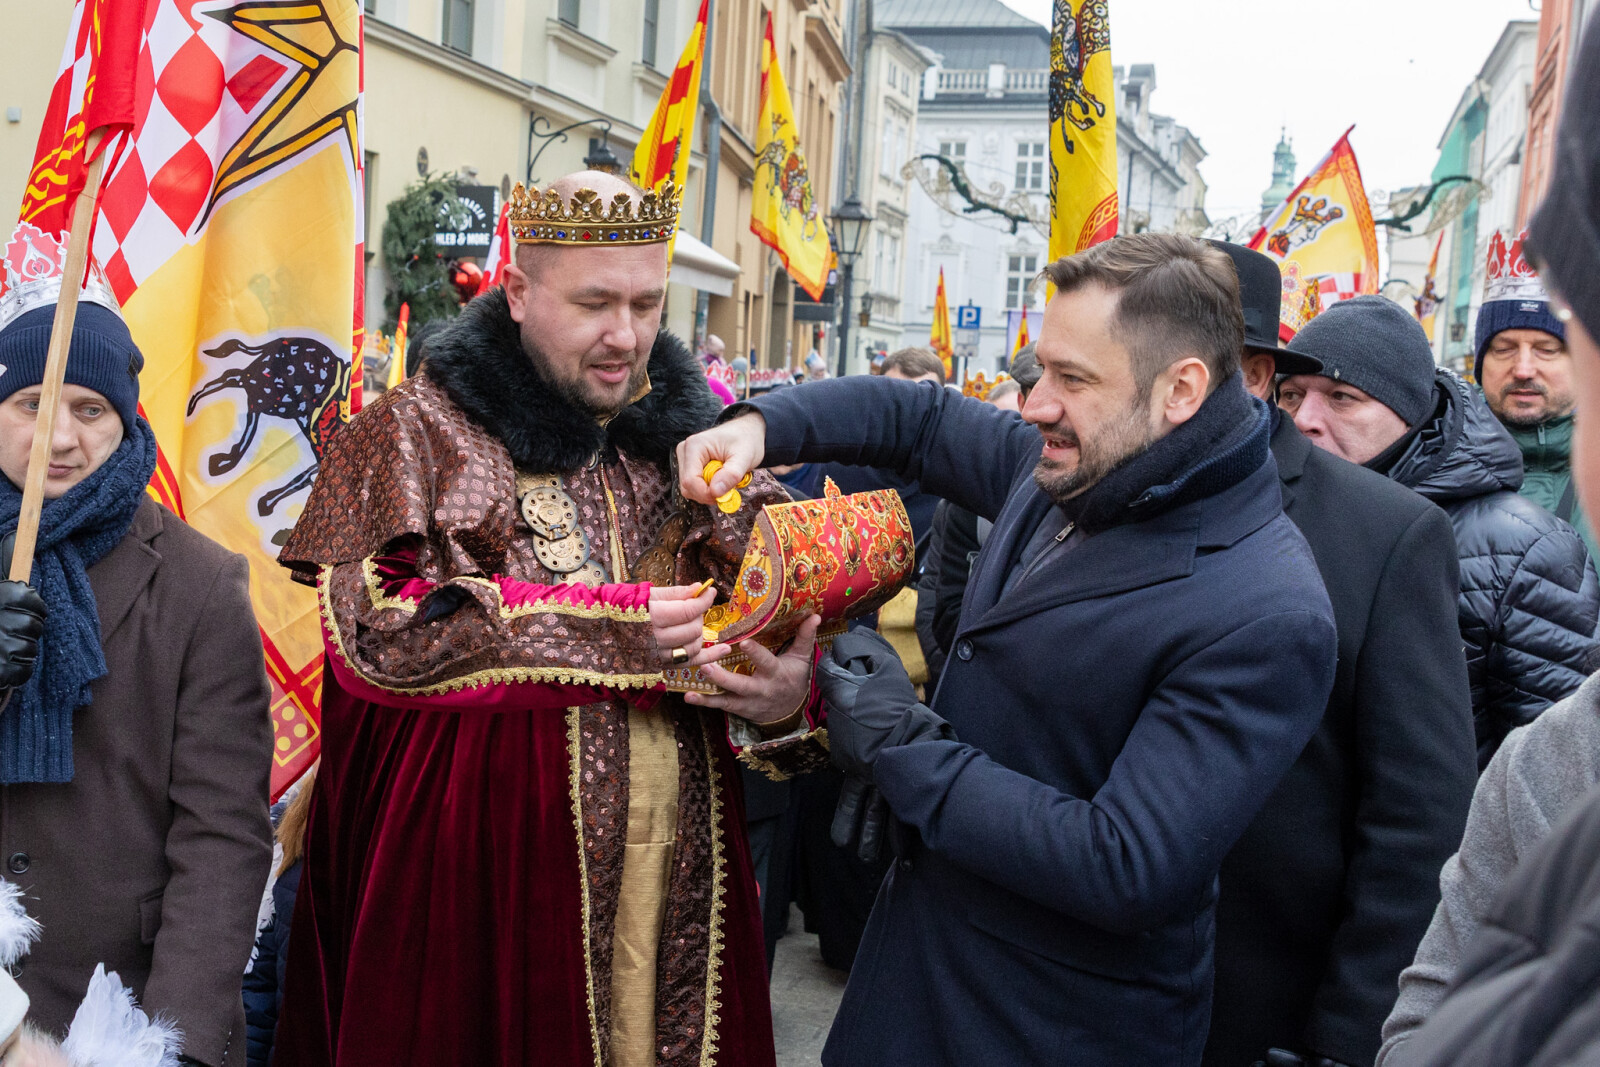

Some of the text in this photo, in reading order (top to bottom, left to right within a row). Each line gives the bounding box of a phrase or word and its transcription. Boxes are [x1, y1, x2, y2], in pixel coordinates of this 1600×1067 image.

[457, 232, 466, 246] &
[466, 232, 490, 246] MORE
[961, 308, 977, 326] P
